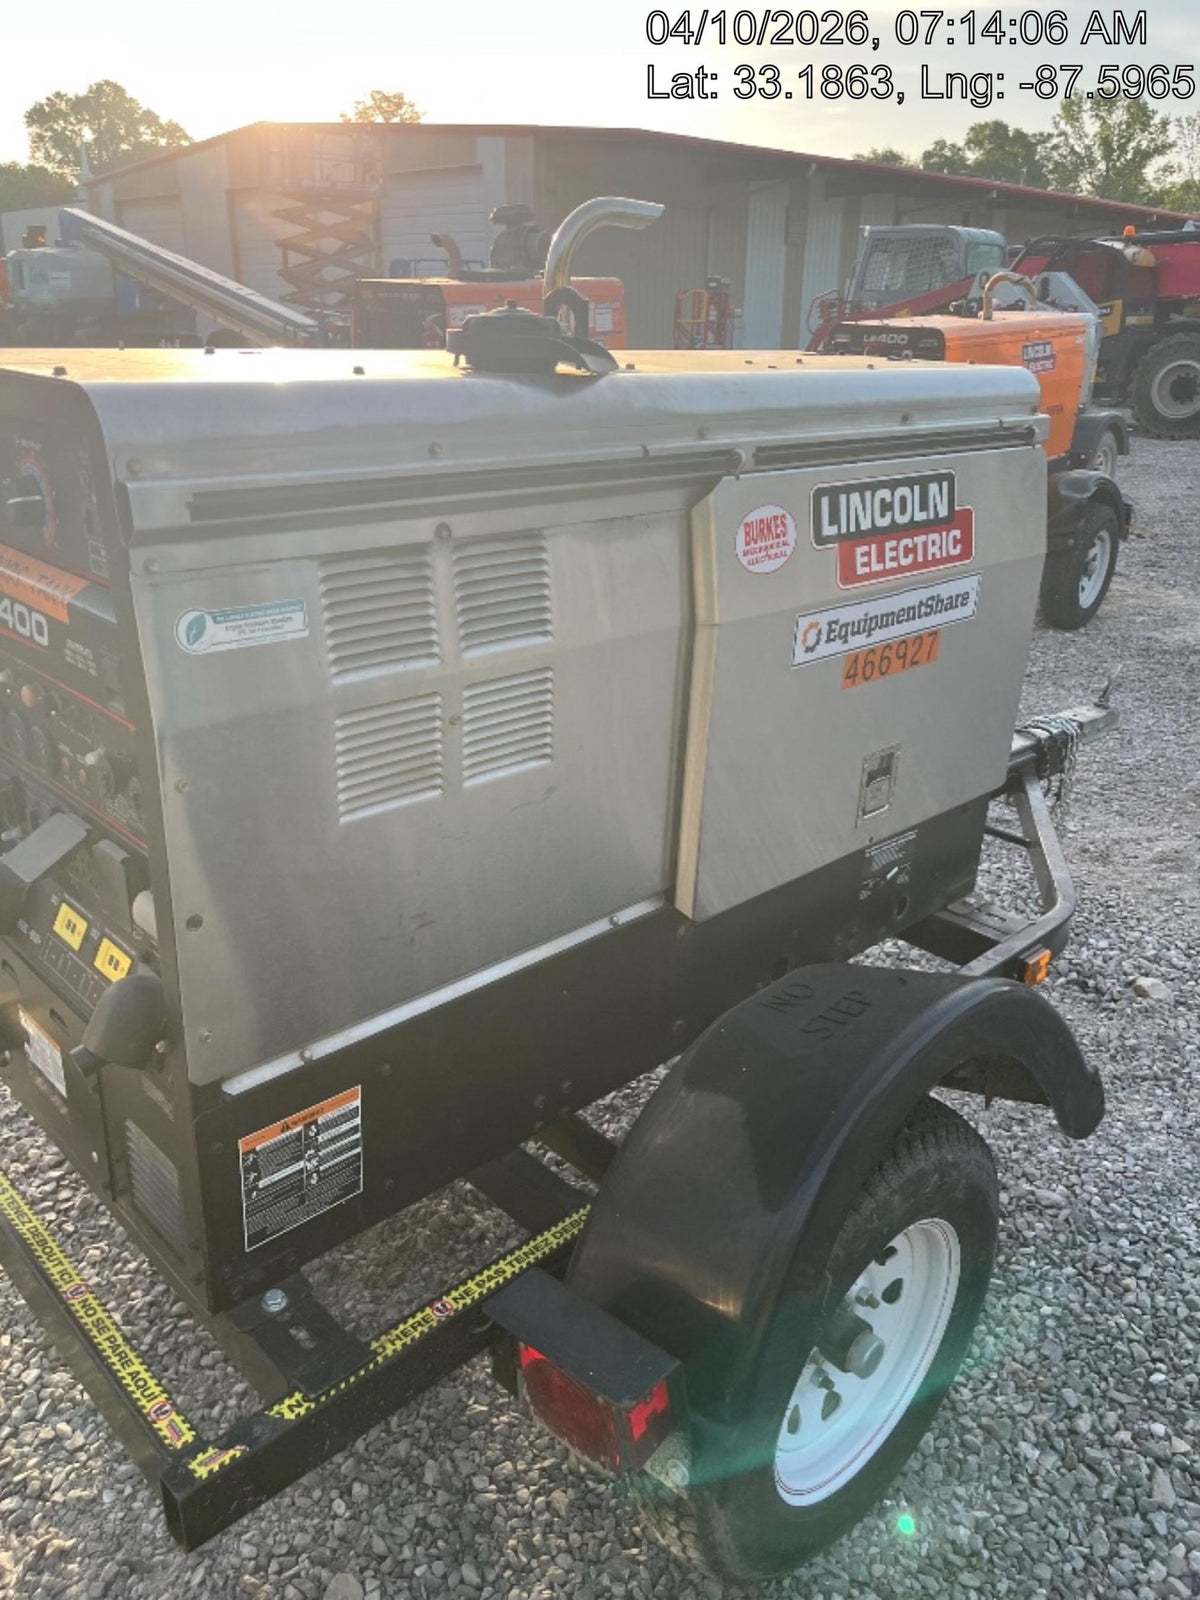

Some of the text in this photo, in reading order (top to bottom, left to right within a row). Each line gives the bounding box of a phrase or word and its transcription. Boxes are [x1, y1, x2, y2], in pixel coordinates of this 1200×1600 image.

[743, 512, 788, 547] BURKES
[820, 480, 949, 537] LINCOLN
[854, 528, 963, 576] ELECTRIC
[0, 597, 49, 647] 400
[823, 589, 970, 645] EquipmentShare
[845, 630, 939, 685] 466927
[760, 983, 815, 1014] NO
[800, 991, 872, 1040] STEP
[6, 1196, 75, 1286] TENEZ DEBOUT ICI
[451, 1281, 475, 1304] NE
[476, 1268, 507, 1292] PAS
[505, 1238, 552, 1270] TENEZ
[77, 1297, 98, 1318] NO
[91, 1316, 111, 1337] SE
[103, 1335, 135, 1369] PARE
[387, 1312, 434, 1347] HERE
